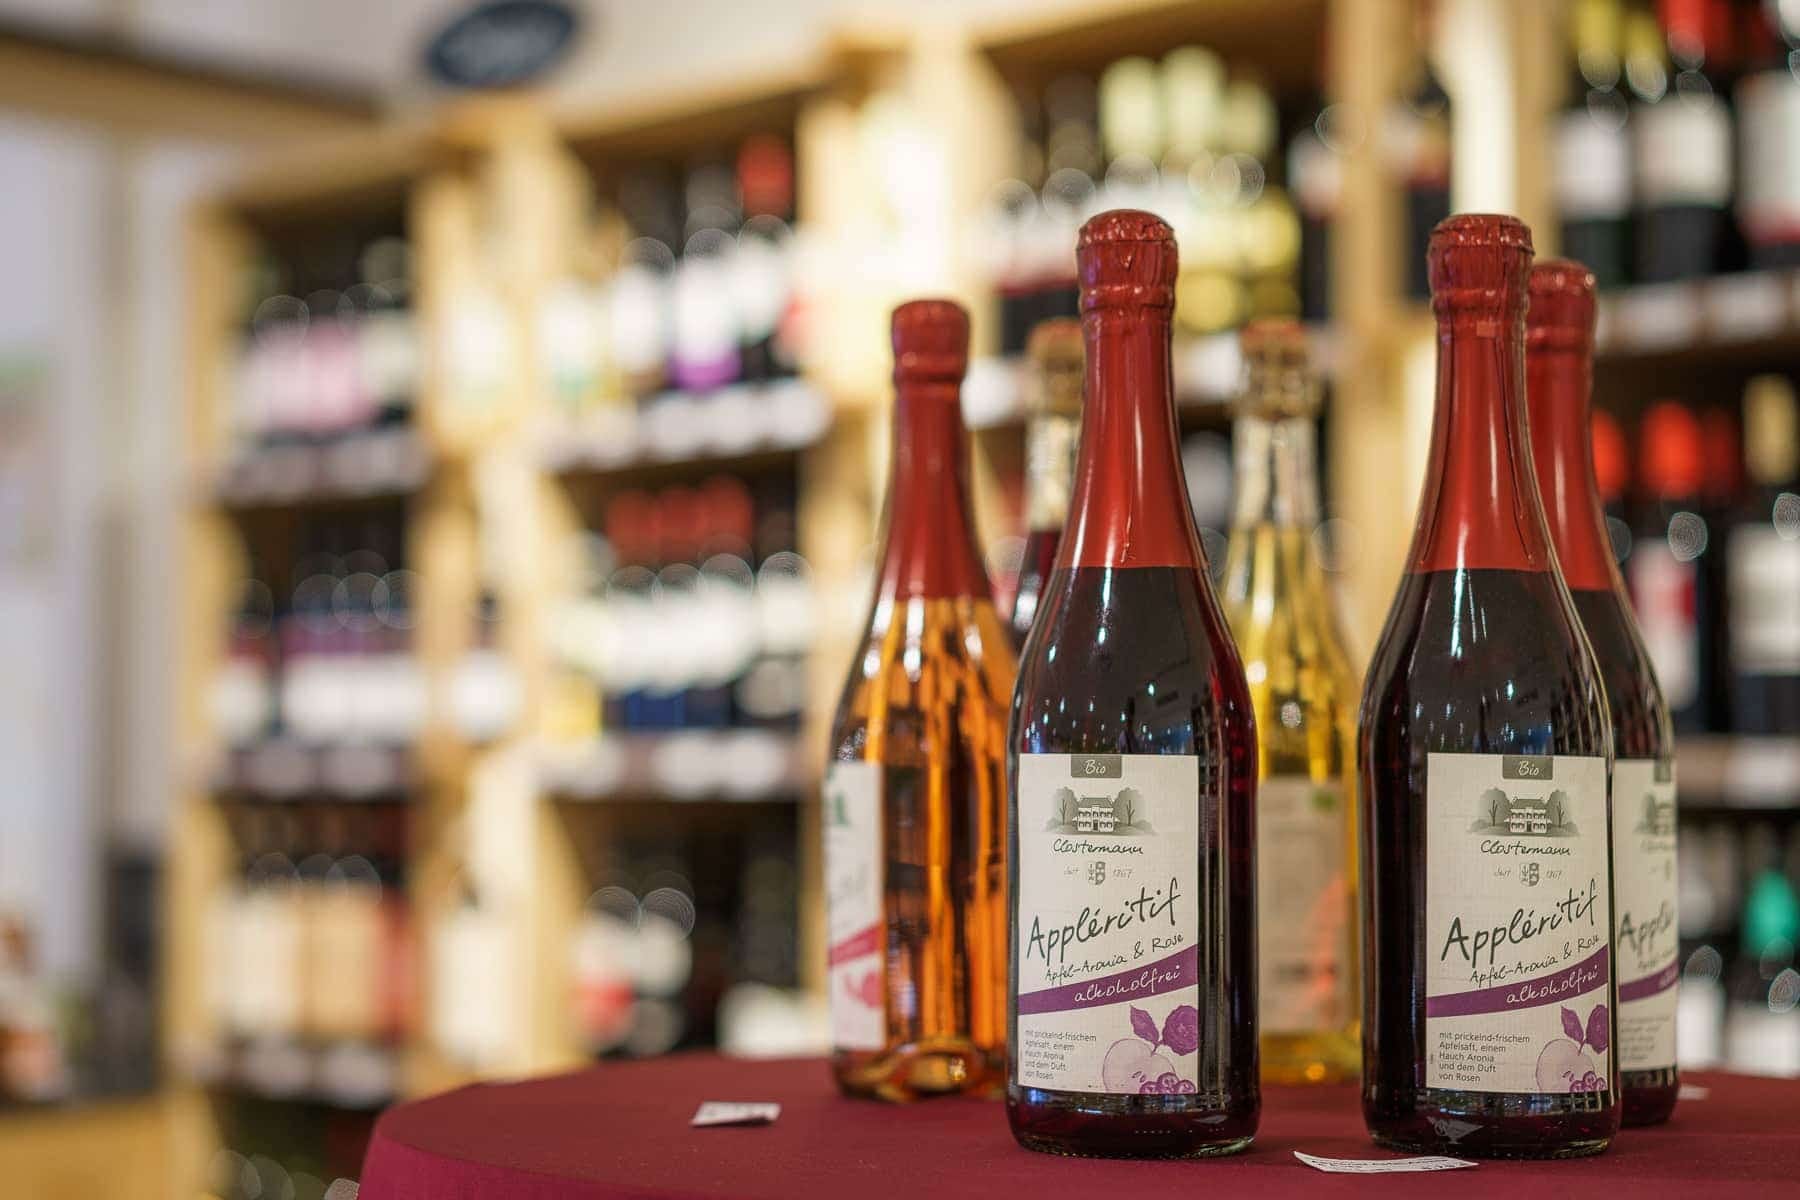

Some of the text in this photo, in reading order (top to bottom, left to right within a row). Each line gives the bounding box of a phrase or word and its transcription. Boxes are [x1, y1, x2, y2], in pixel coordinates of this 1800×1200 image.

[1085, 759, 1107, 775] Bio
[1518, 760, 1540, 776] Bio
[1480, 839, 1571, 855] Clostermann
[1027, 877, 1181, 966] Appléritif
[1441, 878, 1598, 967] Appléritif
[1133, 941, 1145, 960] &
[1152, 933, 1184, 952] Rose
[1470, 956, 1558, 987] Apfel-Aronia
[1563, 942, 1572, 960] &
[1074, 964, 1181, 1002] alkoholfrei
[1507, 964, 1600, 1003] alkoholfrei
[1440, 1031, 1530, 1043] mit prickelnd-frischem
[1439, 1041, 1506, 1053] Apfelsaft, einem
[1439, 1050, 1495, 1062] Hauch Aronia
[1439, 1062, 1497, 1073] und dem Duft
[1439, 1072, 1480, 1082] von Rosen
